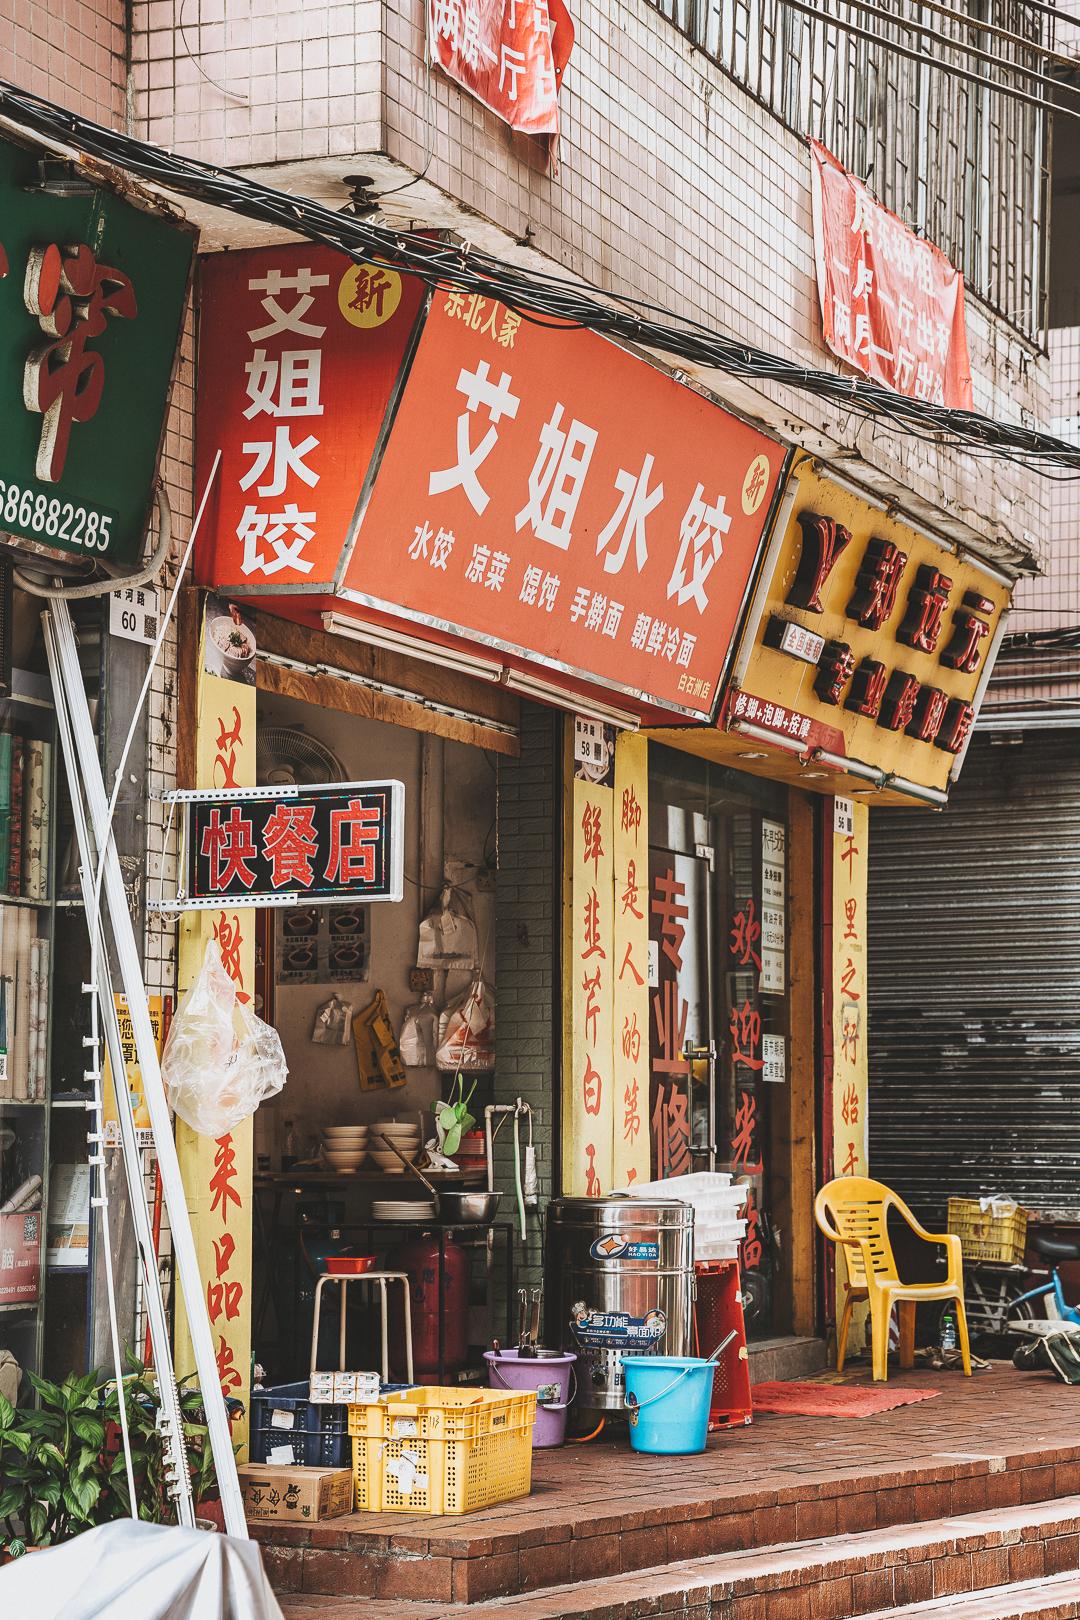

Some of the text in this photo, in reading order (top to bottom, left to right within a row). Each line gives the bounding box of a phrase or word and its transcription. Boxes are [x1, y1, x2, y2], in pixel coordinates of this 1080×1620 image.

[348, 269, 392, 317] 新
[443, 283, 522, 350] 东北人家
[0, 243, 137, 482] 帘
[236, 267, 329, 576] 艾姐水饺
[428, 359, 733, 615] 艾姐水饺
[745, 461, 767, 506] 新
[408, 520, 698, 669] 水饺 凉菜 馄饨 手擀面 朝鲜冷面
[122, 611, 136, 631] 60
[787, 628, 824, 661] 全国连锁
[678, 672, 711, 700] 白石洲店
[734, 693, 812, 738] 修脚+泡脚+按摩
[581, 741, 591, 757] 58
[200, 799, 380, 892] 快餐店
[838, 816, 845, 829] 56
[652, 868, 690, 1180] 专业修
[592, 1314, 629, 1327] 多功能
